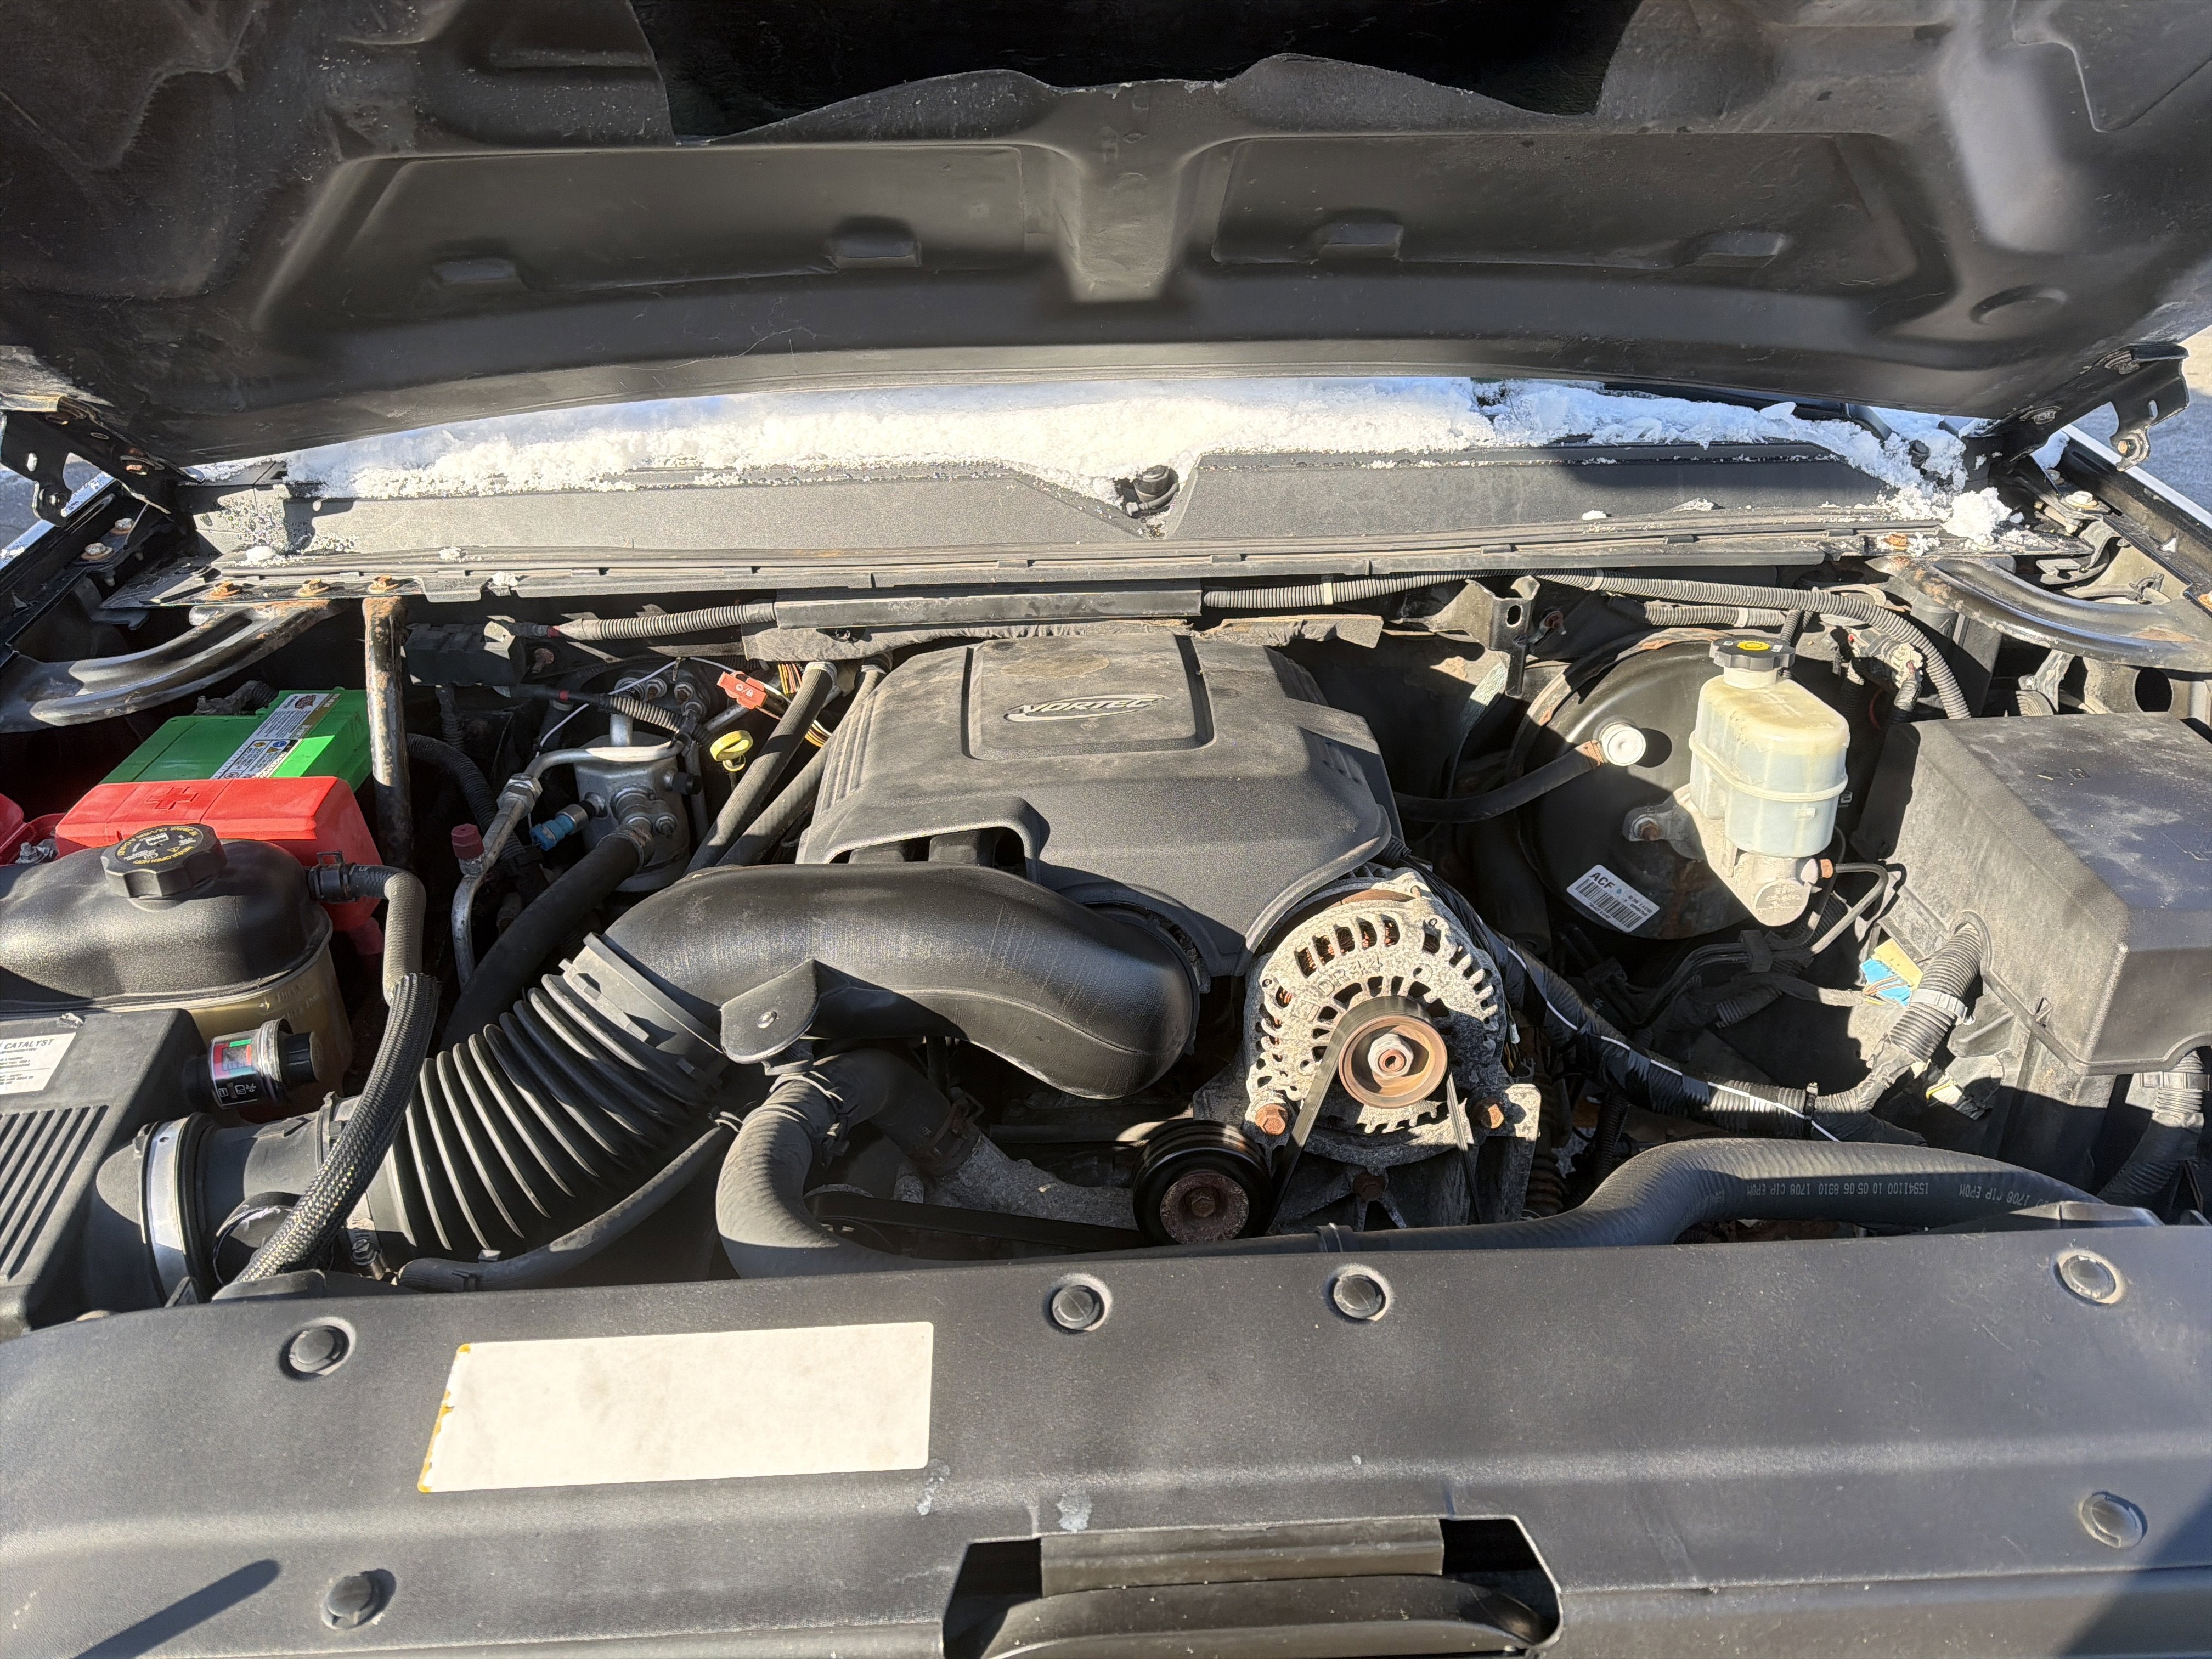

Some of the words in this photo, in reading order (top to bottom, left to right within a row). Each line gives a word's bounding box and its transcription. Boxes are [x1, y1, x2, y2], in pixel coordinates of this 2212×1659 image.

[1022, 699, 1157, 713] VORTEC
[135, 828, 168, 839] OUVRIR
[150, 855, 172, 864] OPEN
[1589, 872, 1616, 889] ACF
[4, 1039, 55, 1049] CATALYST
[1790, 1183, 1810, 1195] 1708
[1843, 1182, 1855, 1194] 06
[1857, 1182, 1869, 1194] 05
[1872, 1182, 1883, 1195] 10
[1887, 1182, 1929, 1195] 15941100
[2006, 1190, 2030, 1207] 1708
